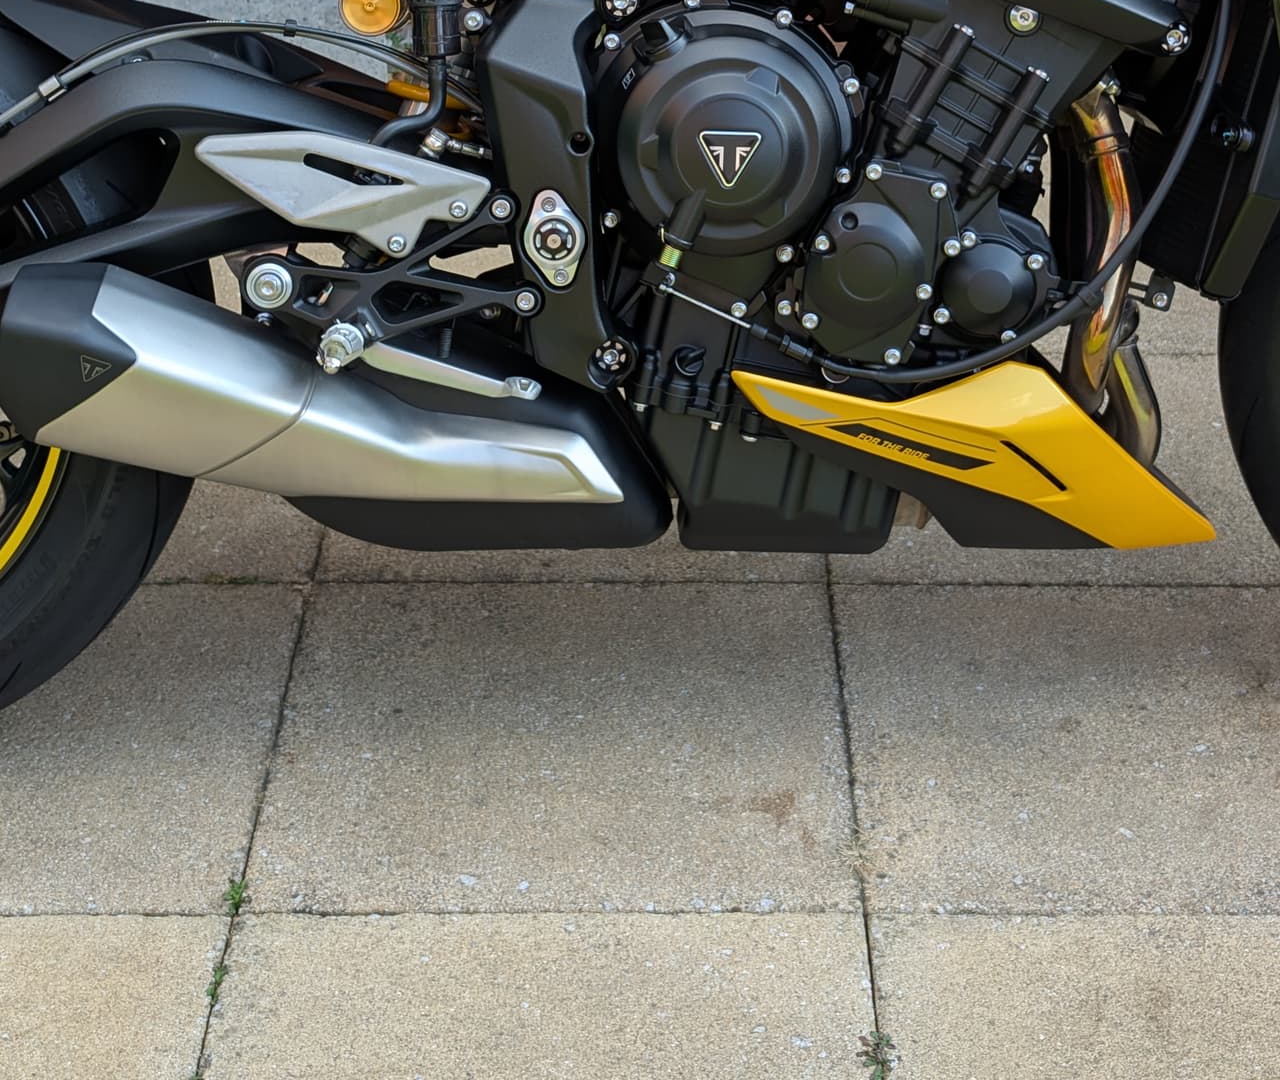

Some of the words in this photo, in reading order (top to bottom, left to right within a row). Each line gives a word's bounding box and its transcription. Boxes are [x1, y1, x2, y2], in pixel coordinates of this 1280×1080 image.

[857, 432, 881, 445] FOR
[881, 439, 904, 453] THE
[902, 447, 931, 460] RIDE
